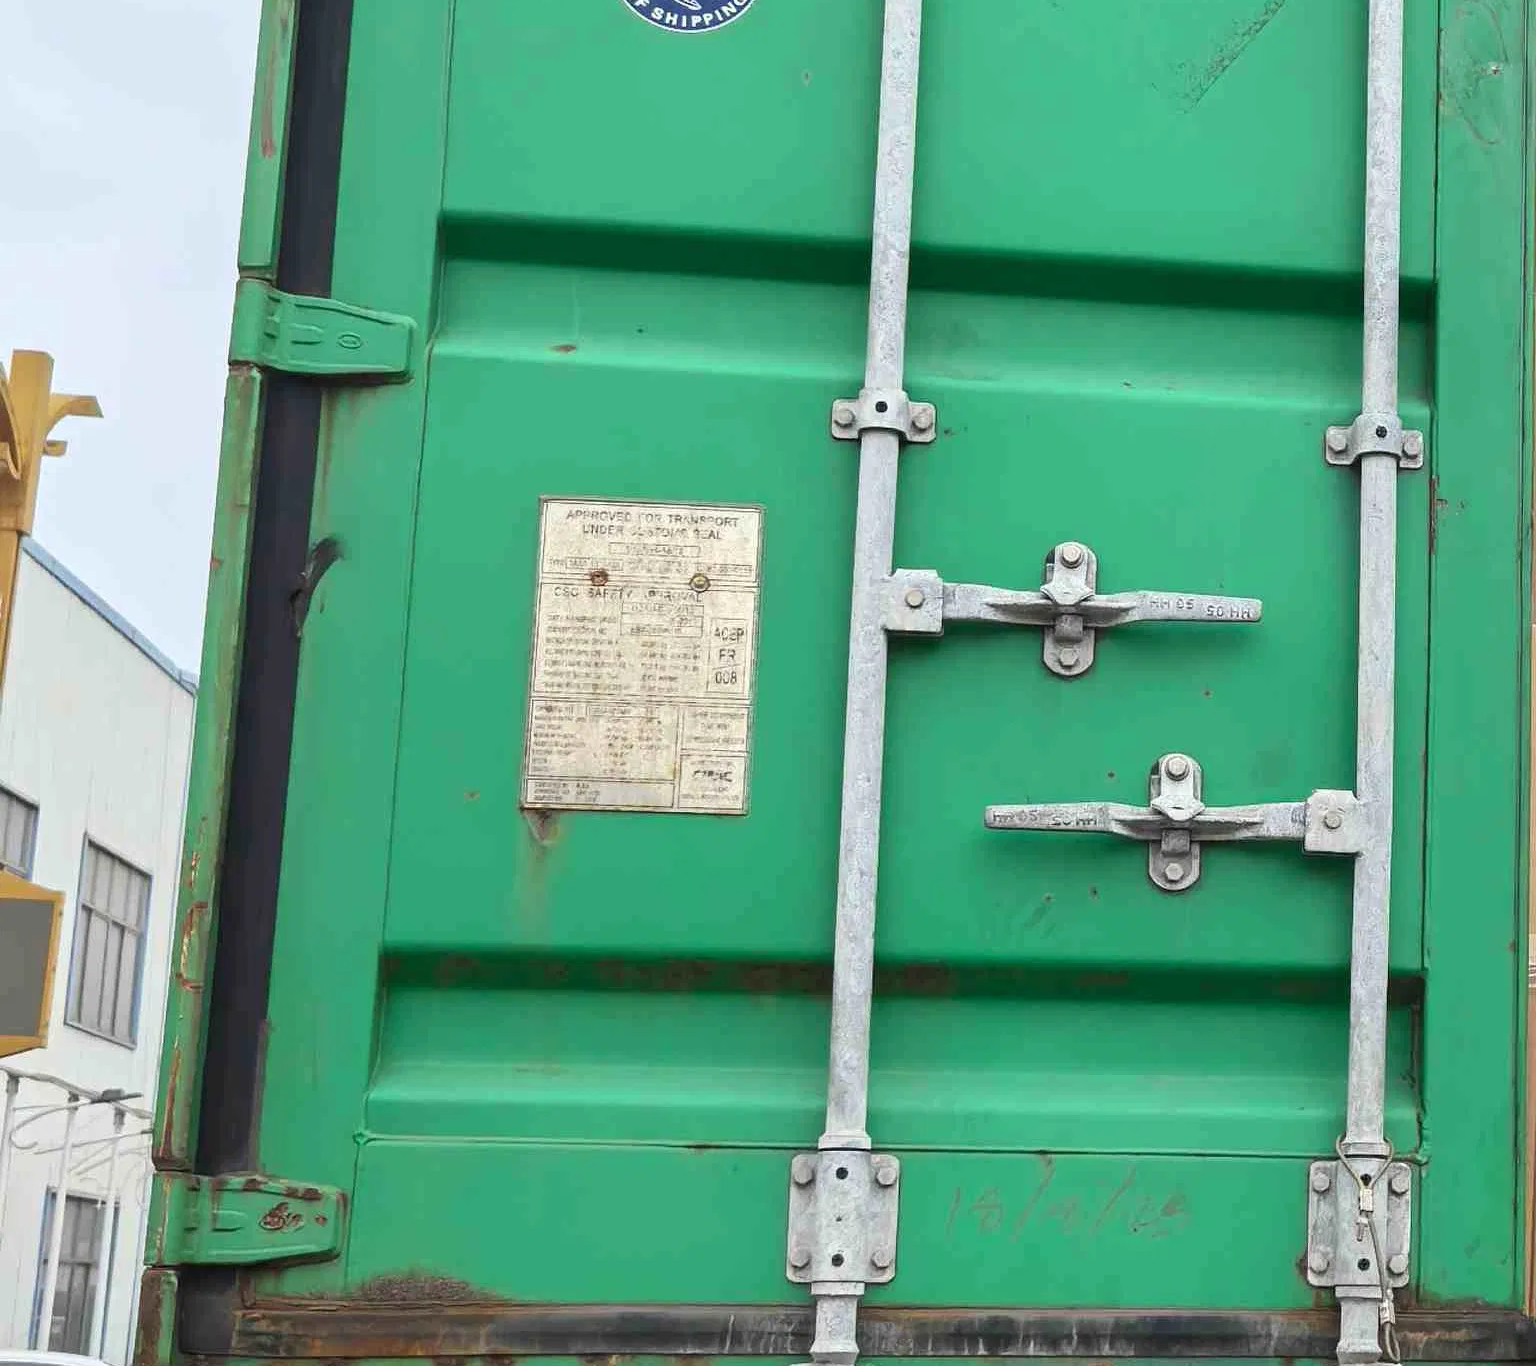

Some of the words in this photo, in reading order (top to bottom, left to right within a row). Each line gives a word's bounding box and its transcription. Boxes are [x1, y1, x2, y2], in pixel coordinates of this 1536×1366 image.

[566, 510, 632, 523] APPROVED
[582, 524, 624, 536] UNDER
[553, 586, 578, 598] CSC
